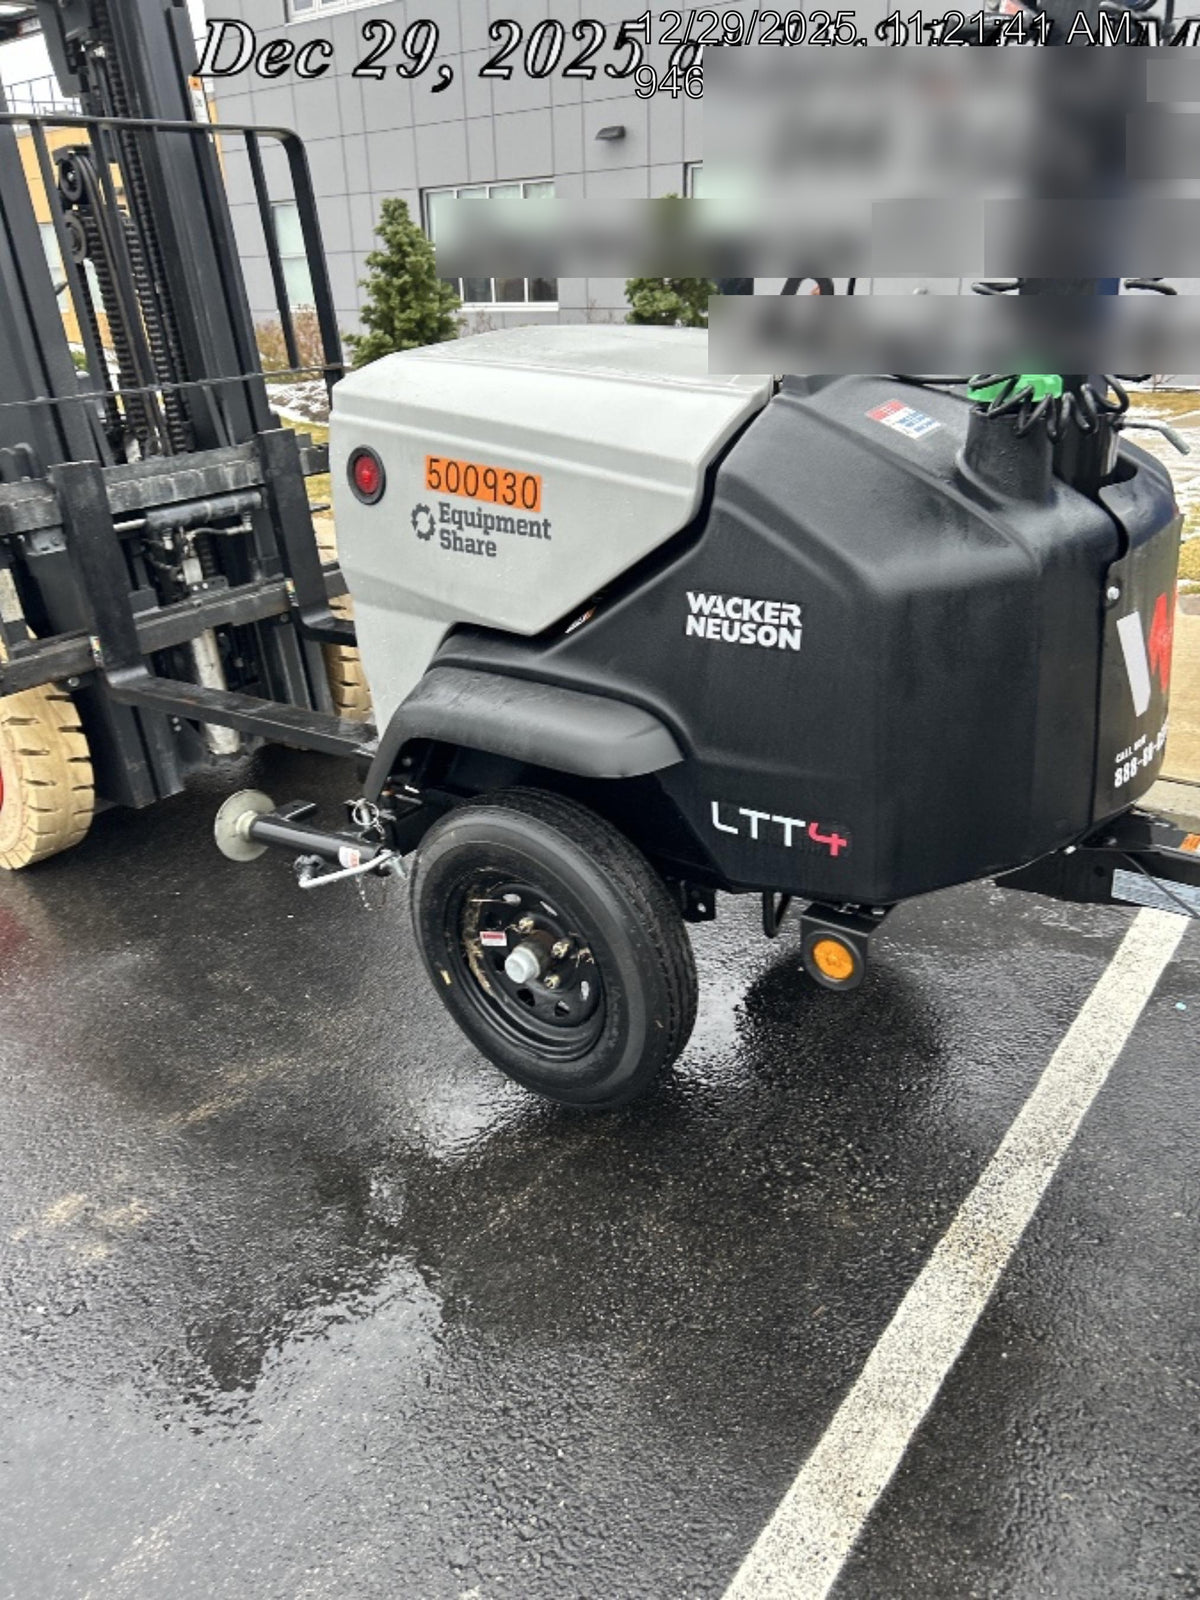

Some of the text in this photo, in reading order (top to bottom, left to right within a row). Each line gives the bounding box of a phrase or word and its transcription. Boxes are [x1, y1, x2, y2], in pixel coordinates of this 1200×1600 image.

[427, 457, 539, 510] 500930
[438, 501, 552, 541] Equipment
[439, 528, 497, 557] Share
[685, 591, 803, 627] WACKER
[685, 614, 802, 651] NEUSON
[710, 800, 848, 857] LTT4
